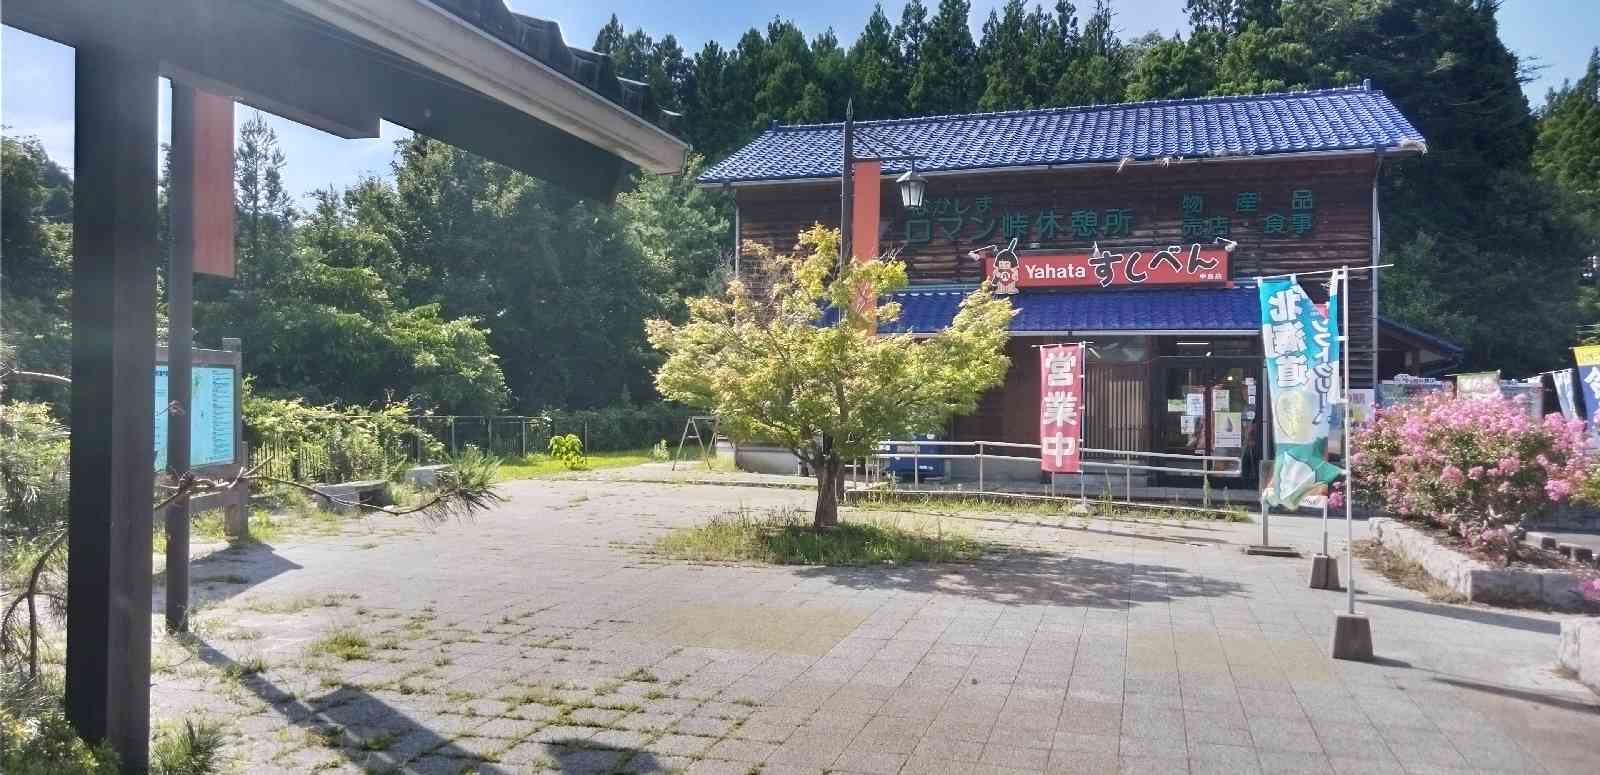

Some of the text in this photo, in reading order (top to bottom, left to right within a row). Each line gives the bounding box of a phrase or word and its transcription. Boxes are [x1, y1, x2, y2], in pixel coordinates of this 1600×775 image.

[905, 208, 1131, 241] ロマン峠休憩所
[1025, 243, 1219, 287] Yahata すしべん
[1043, 352, 1077, 468] 営業中
